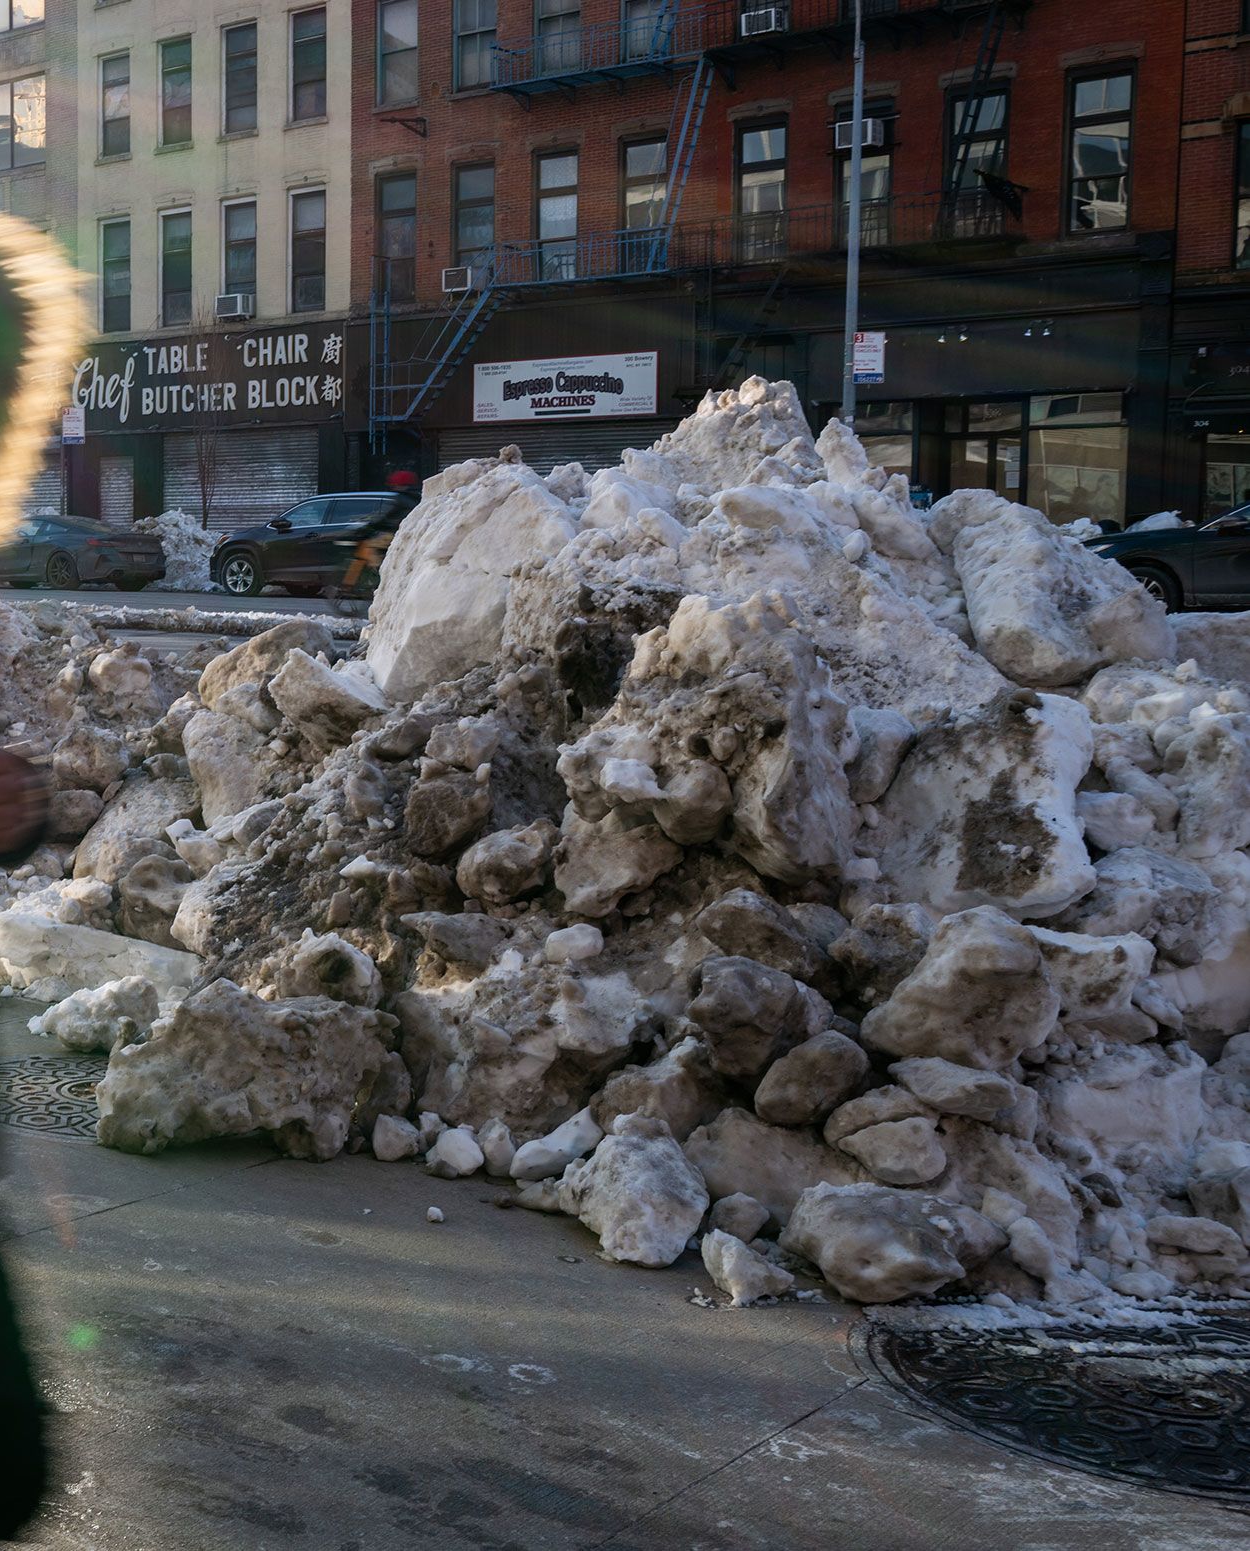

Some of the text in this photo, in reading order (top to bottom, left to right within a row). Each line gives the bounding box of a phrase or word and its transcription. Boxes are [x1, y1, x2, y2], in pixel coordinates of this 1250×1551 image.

[145, 333, 309, 376] TABLE CHAIR
[72, 357, 135, 424] Chef
[141, 375, 319, 416] BUTCHER BLOCK
[503, 371, 624, 401] Espresso Cappuccino
[530, 395, 595, 408] MACHINES
